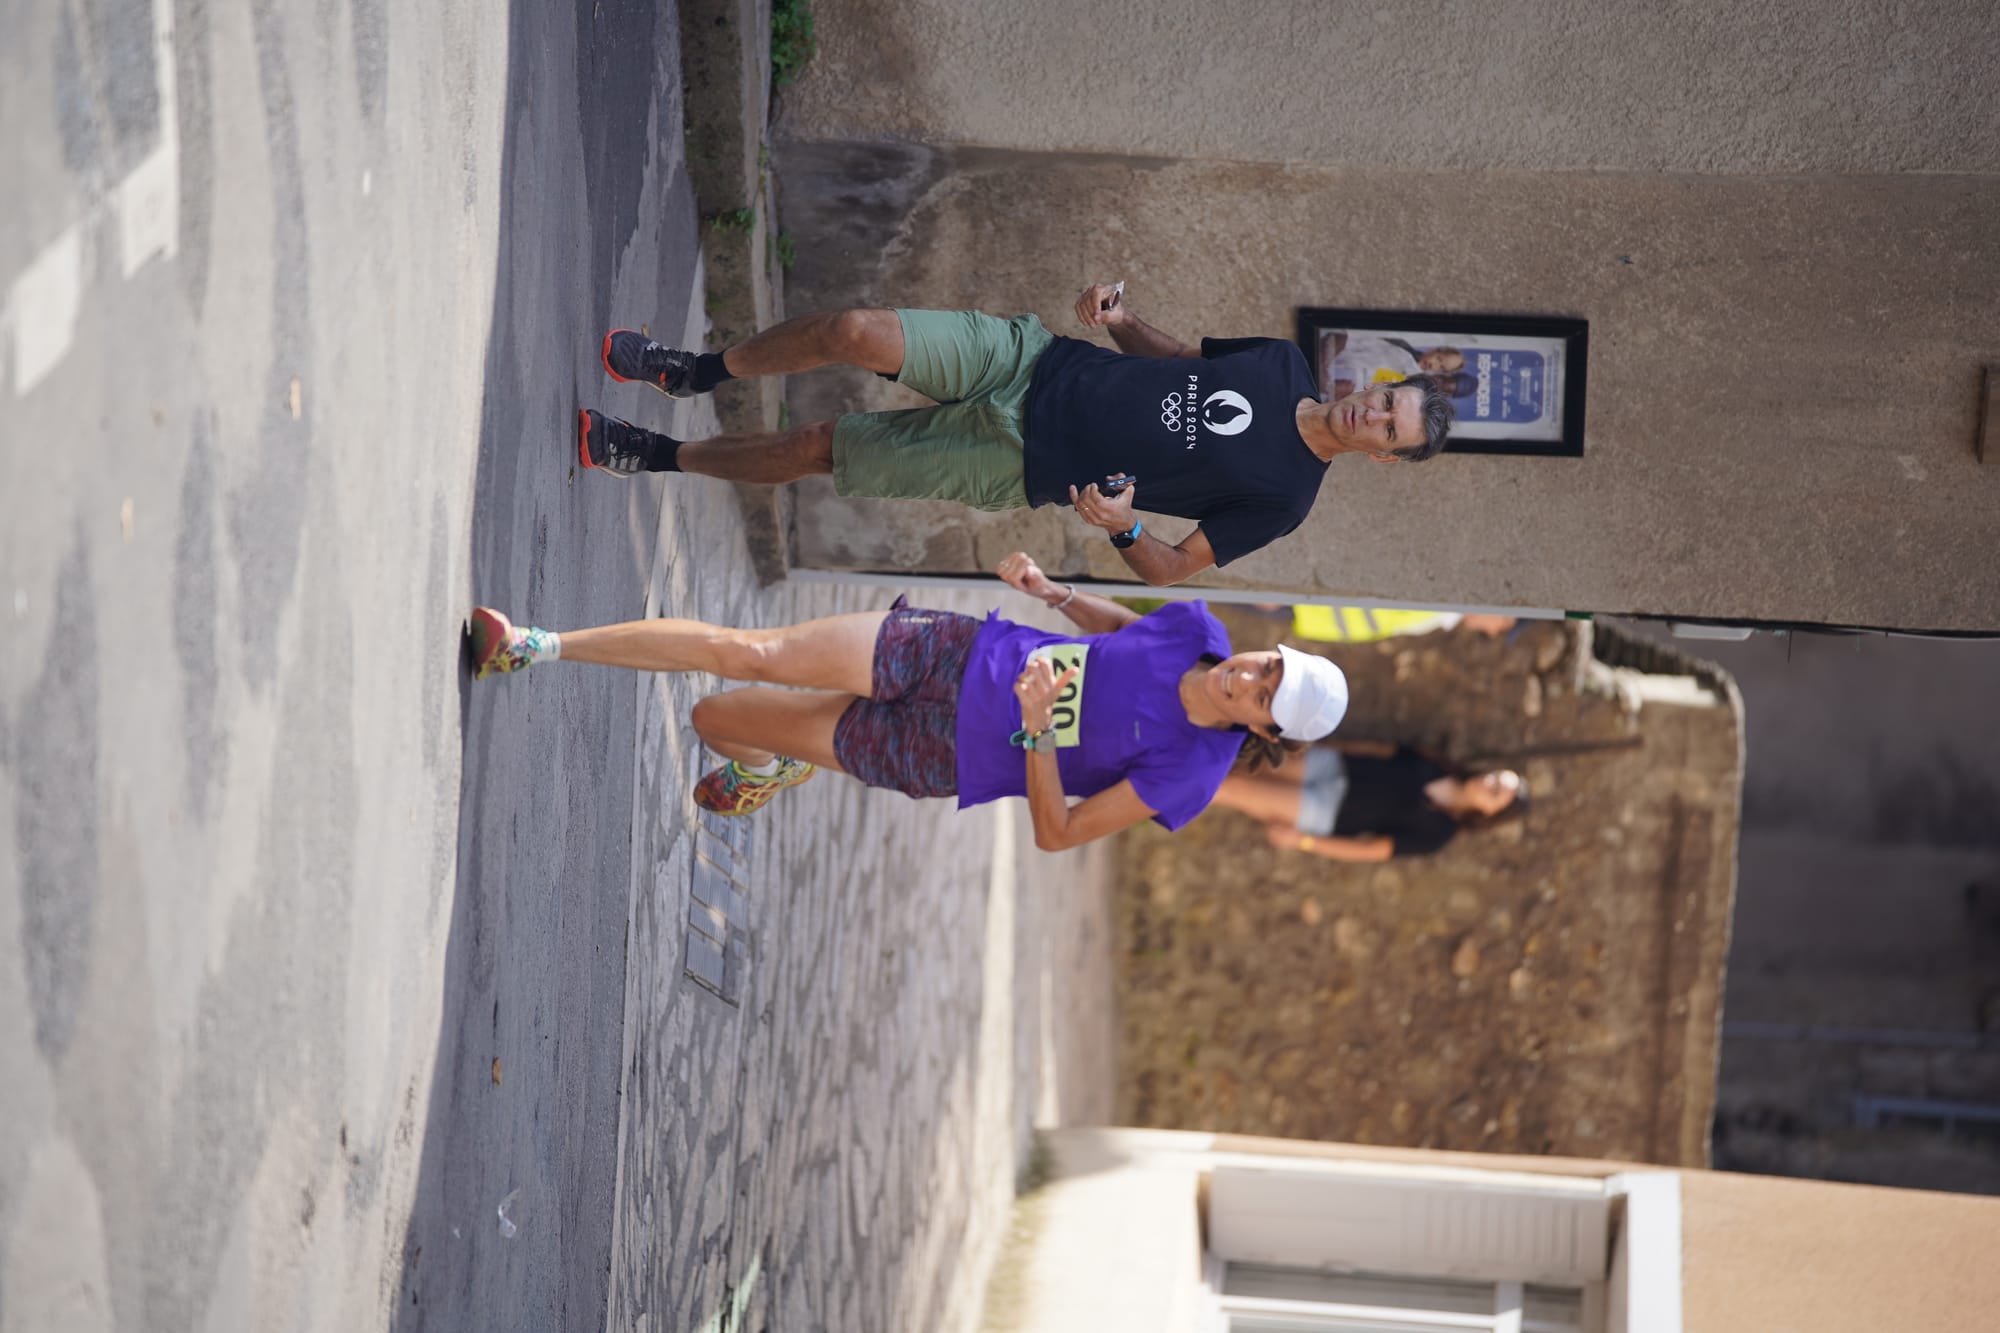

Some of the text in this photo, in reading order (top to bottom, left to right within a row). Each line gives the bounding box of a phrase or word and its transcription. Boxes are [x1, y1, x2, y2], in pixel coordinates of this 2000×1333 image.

[1186, 375, 1198, 450] PARIS 2024
[1476, 353, 1492, 417] RÉPONDEUR
